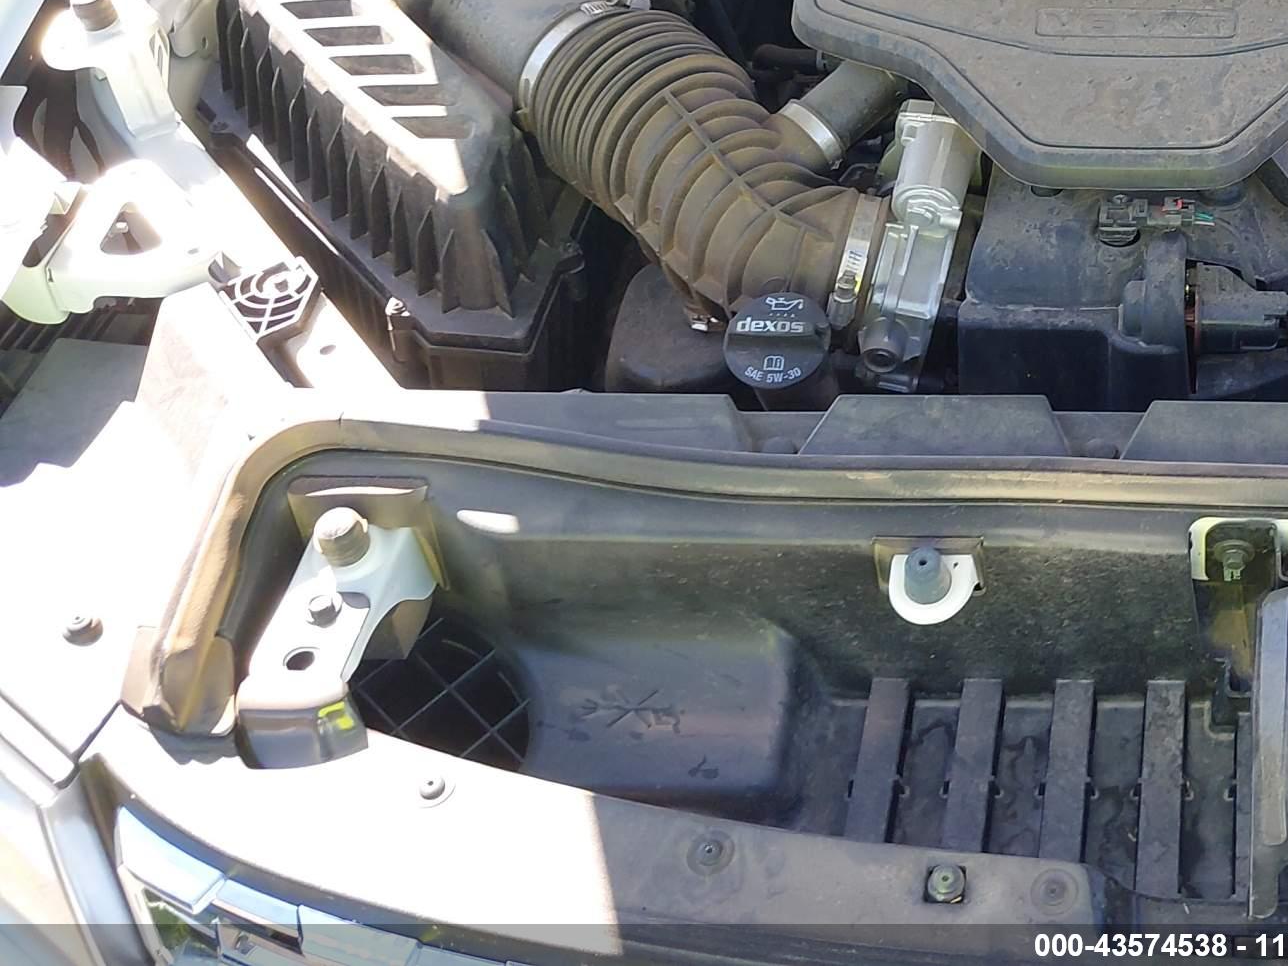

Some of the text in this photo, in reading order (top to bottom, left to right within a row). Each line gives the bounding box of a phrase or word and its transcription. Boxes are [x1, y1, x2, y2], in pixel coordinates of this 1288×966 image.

[735, 317, 805, 333] dexos
[744, 366, 802, 383] SAE 5W-30
